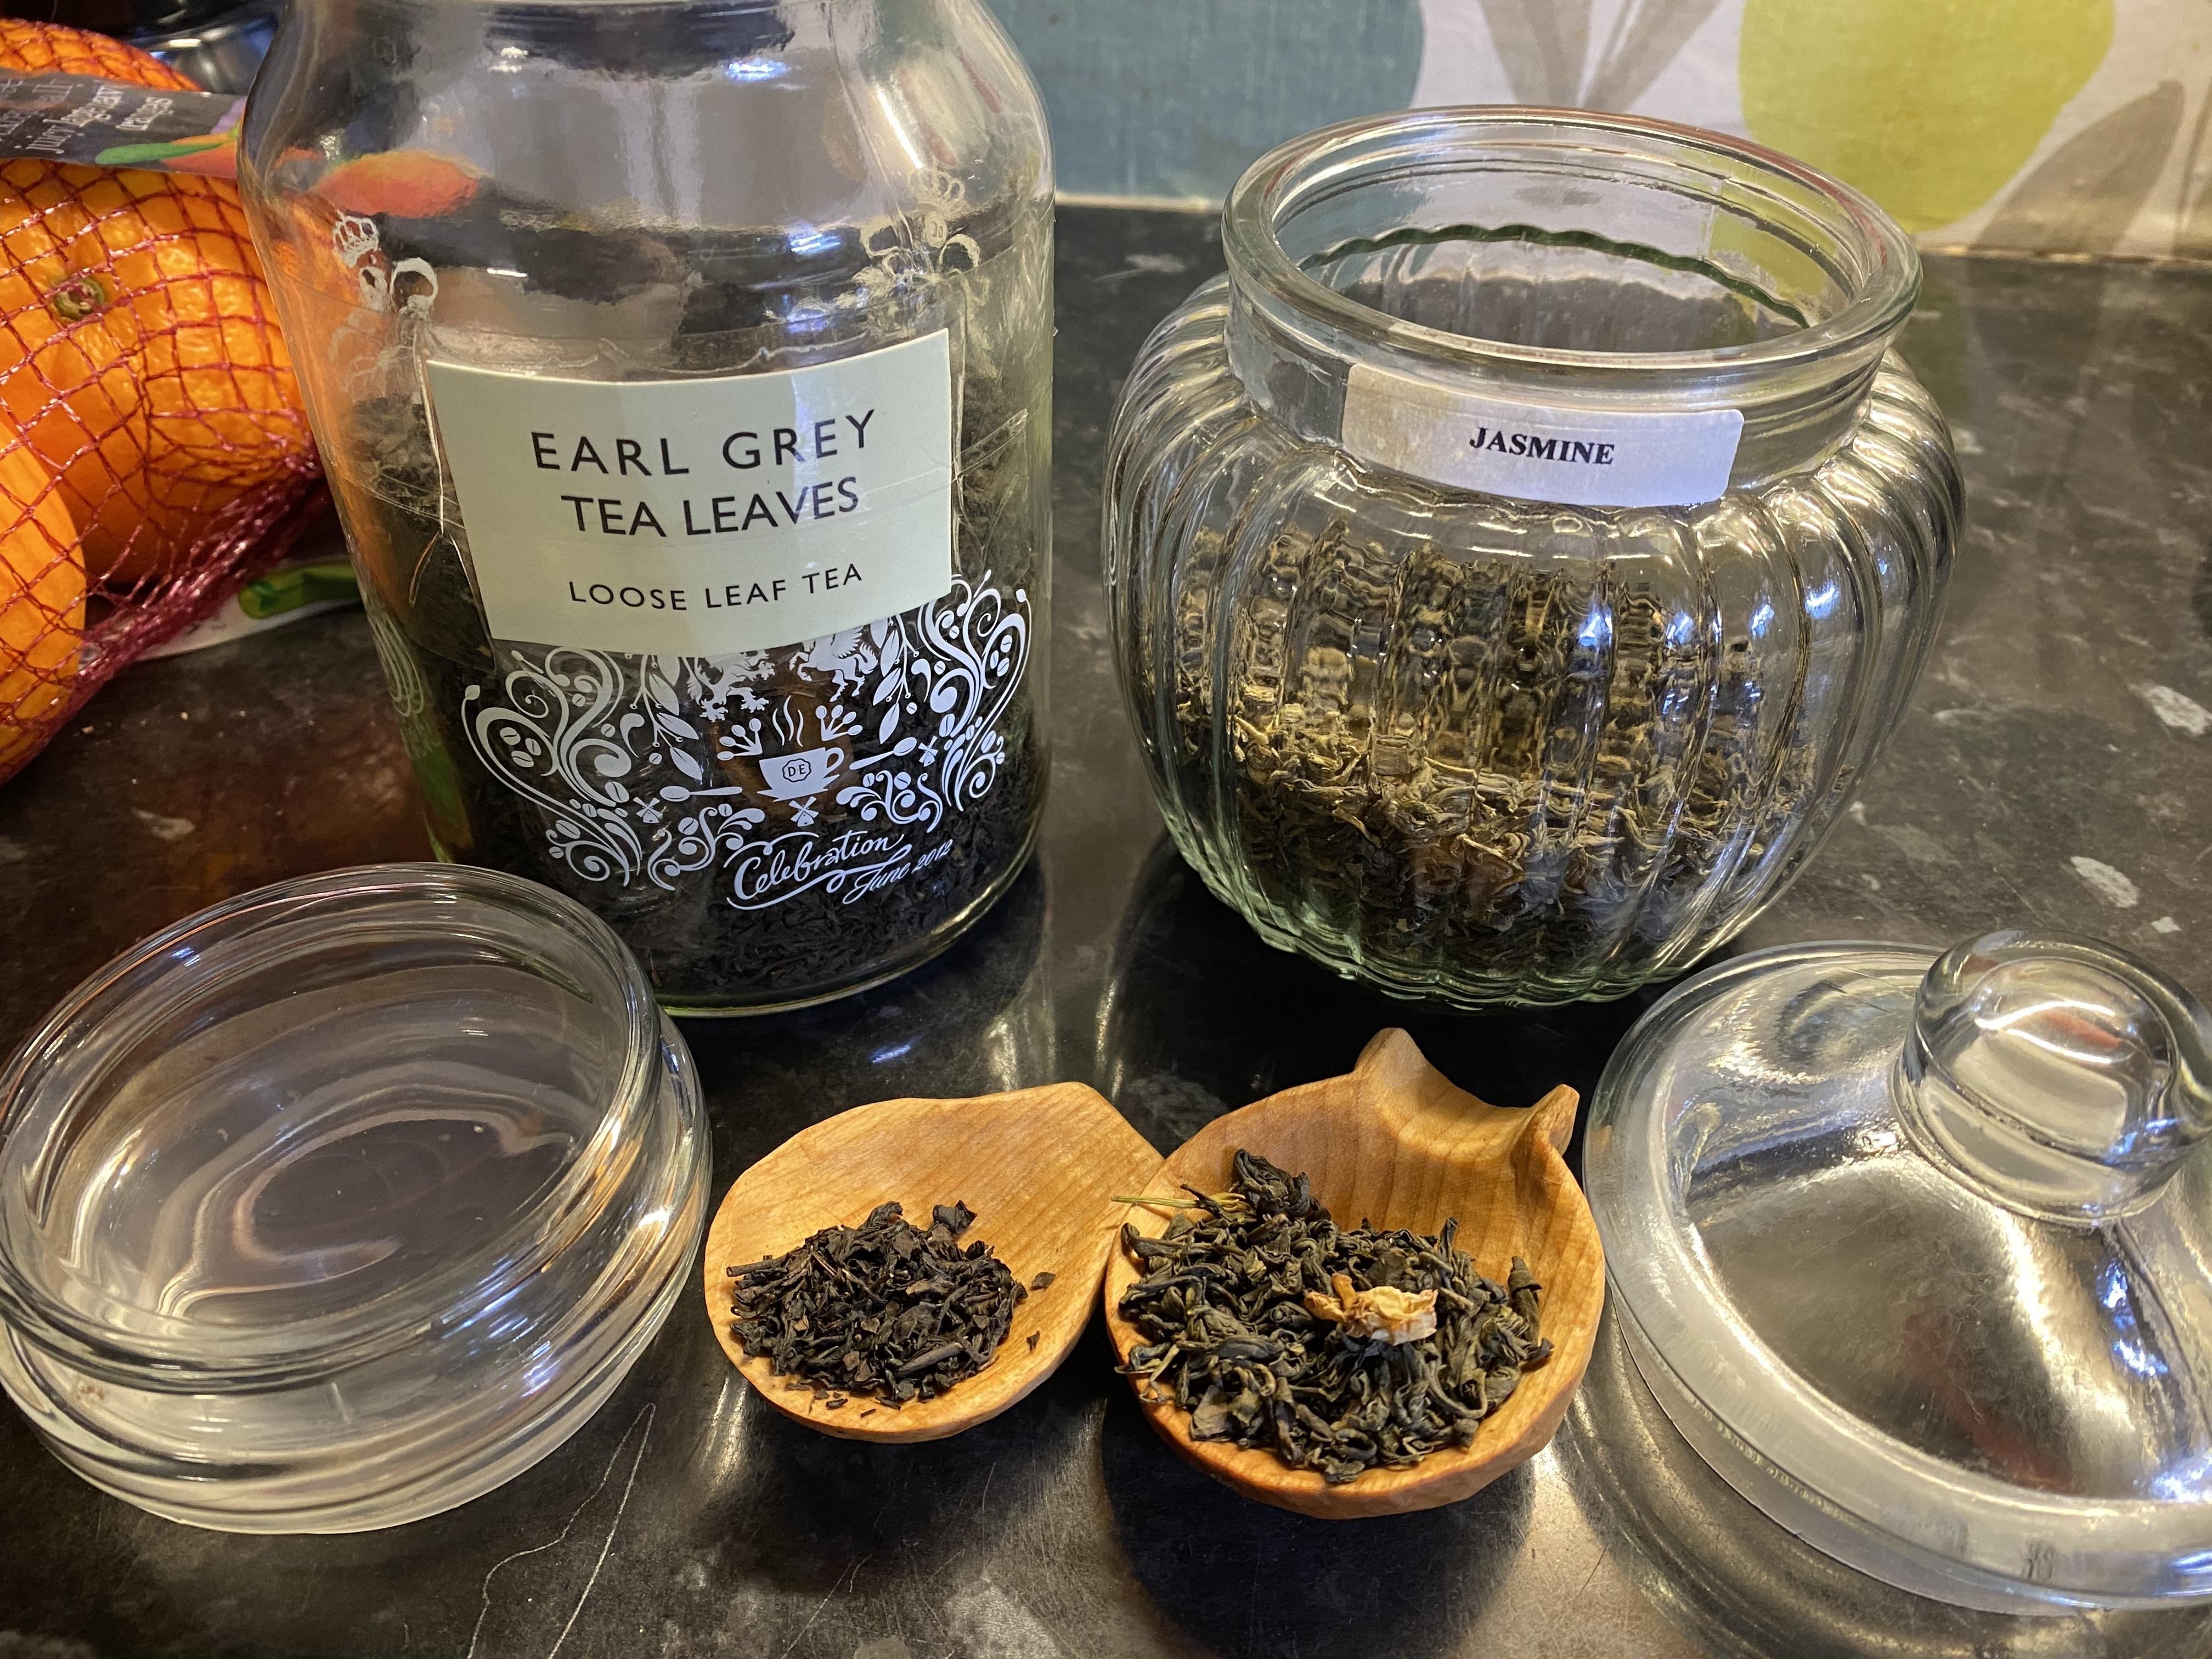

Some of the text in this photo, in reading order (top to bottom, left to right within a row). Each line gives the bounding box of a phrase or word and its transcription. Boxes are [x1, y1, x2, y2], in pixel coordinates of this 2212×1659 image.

[531, 409, 874, 476] EARL GREY
[1469, 427, 1615, 465] JASMINE
[560, 476, 859, 538] TEA LEAVES
[569, 563, 862, 611] LOOSE LEAF TEA
[733, 830, 905, 900] Celebration
[843, 839, 953, 904] June 2012
